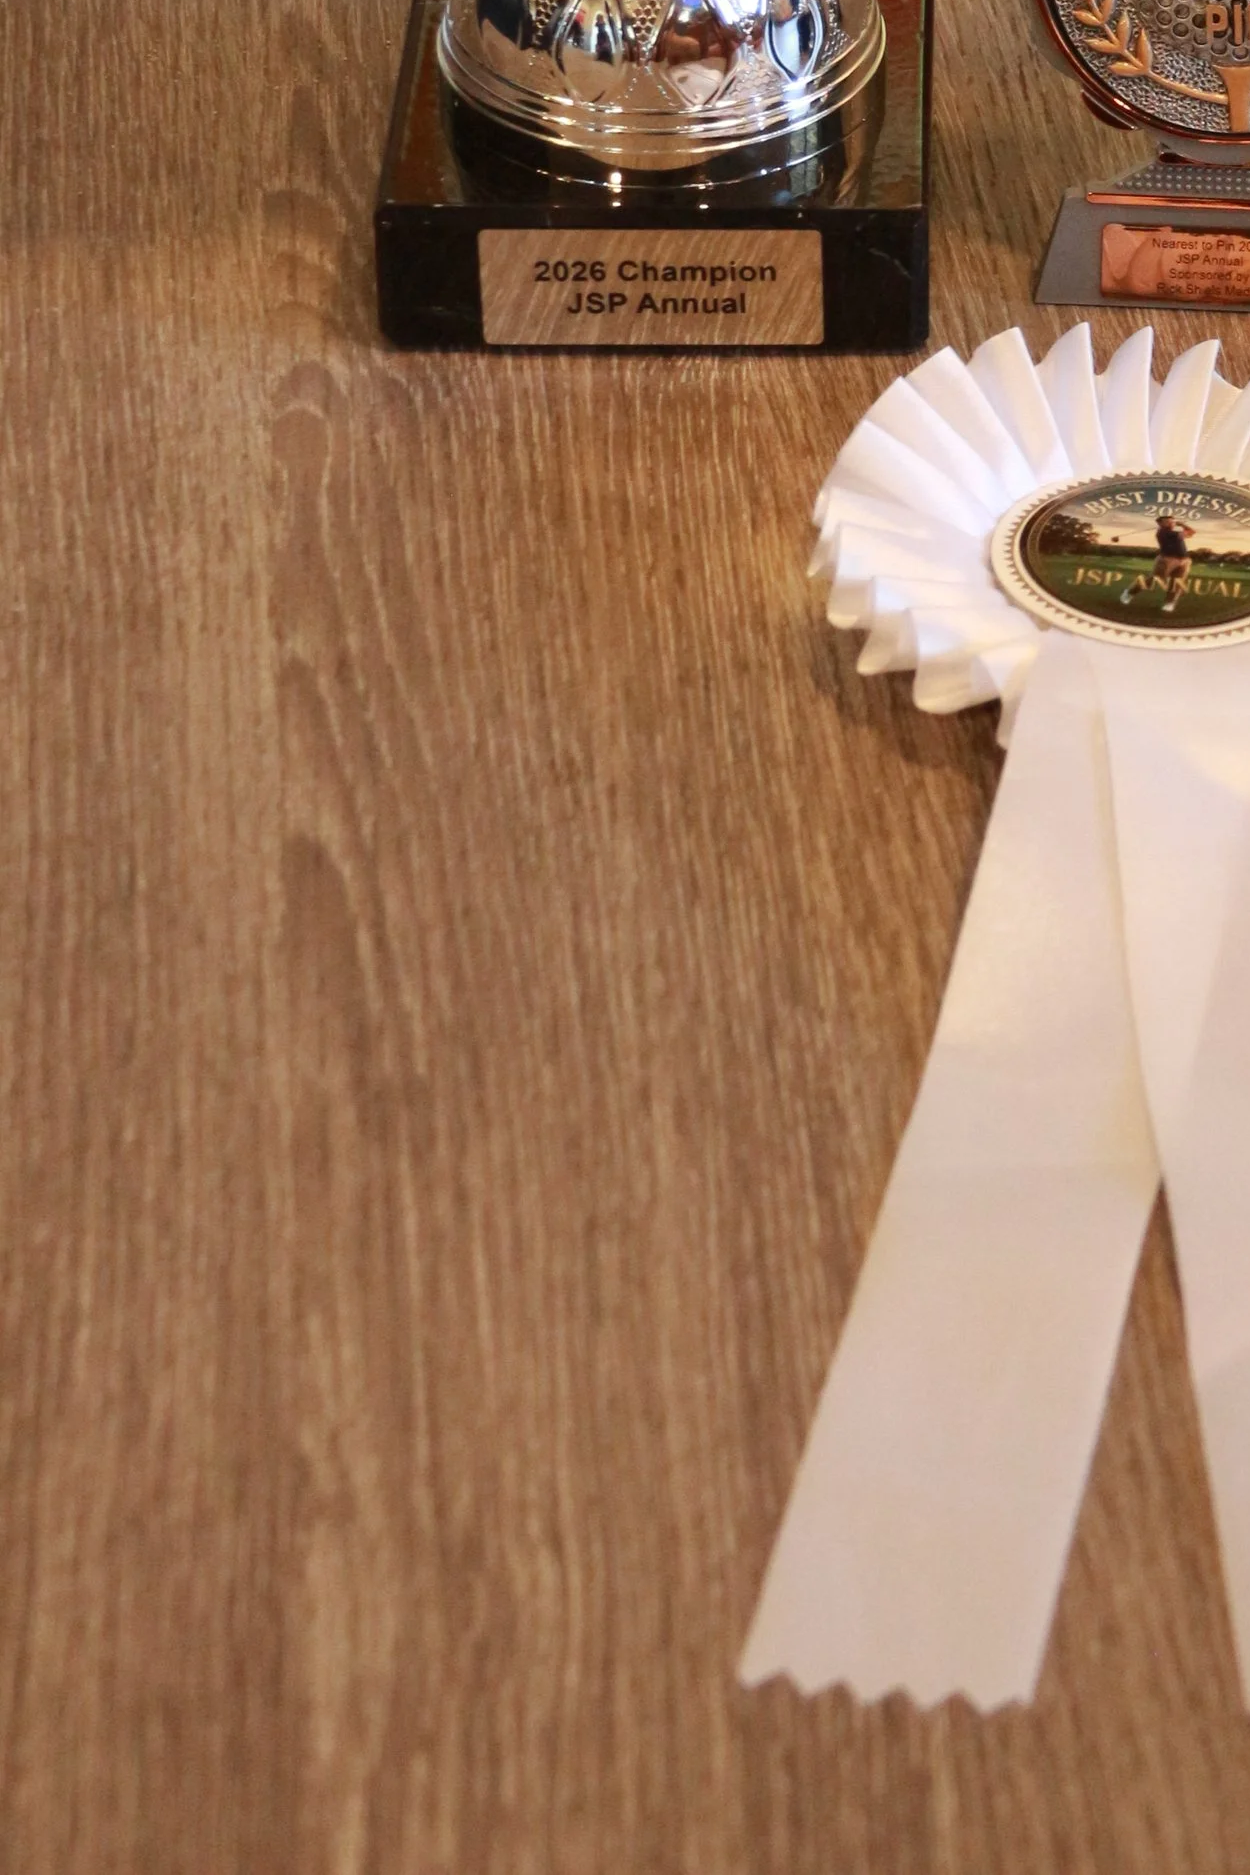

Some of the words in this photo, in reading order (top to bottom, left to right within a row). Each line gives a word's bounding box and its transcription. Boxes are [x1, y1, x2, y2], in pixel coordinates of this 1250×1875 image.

[1152, 238, 1198, 250] Nearest
[1202, 240, 1212, 250] to
[1216, 240, 1235, 252] Pin
[1175, 254, 1200, 265] JSP
[1203, 255, 1244, 267] Annual
[534, 260, 606, 283] 2026
[618, 260, 777, 287] Champion
[1169, 268, 1232, 281] Sponsored
[1235, 271, 1250, 284] by
[1157, 283, 1181, 295] Rck
[1186, 283, 1221, 296] Shels
[567, 292, 628, 314] JSP
[636, 292, 747, 314] Annual
[1084, 490, 1145, 520] BEST
[1144, 504, 1202, 522] 2026
[1068, 568, 1123, 587] JSP
[1132, 574, 1250, 600] ANNUAL
